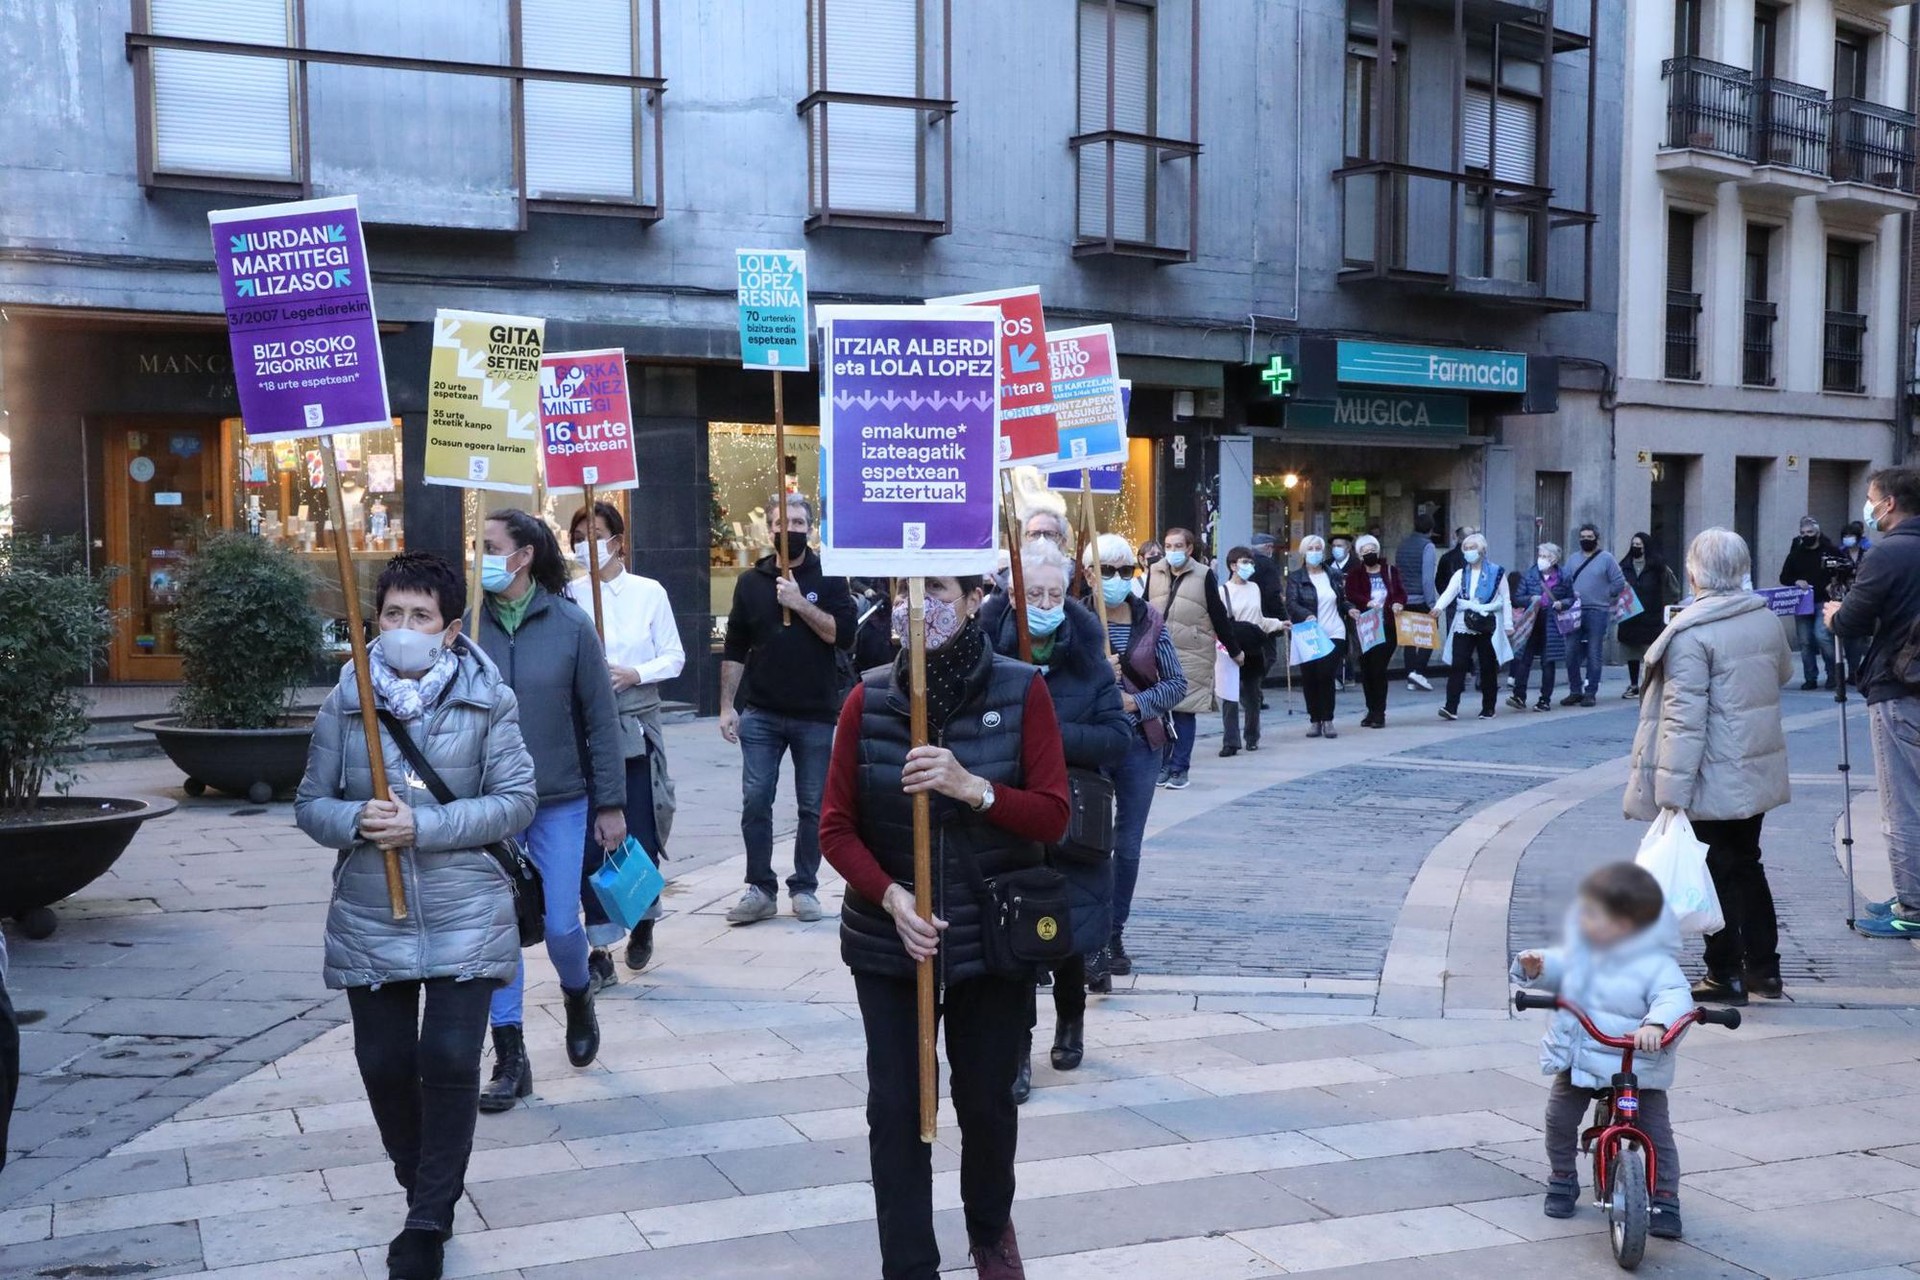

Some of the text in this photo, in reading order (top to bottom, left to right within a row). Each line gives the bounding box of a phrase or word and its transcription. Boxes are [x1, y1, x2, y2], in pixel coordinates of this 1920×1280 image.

[248, 226, 330, 252] IURDAN
[232, 247, 350, 277] MARTITEGI
[737, 256, 783, 273] LOLA
[255, 271, 334, 297] LIZASO
[738, 272, 795, 291] LOPEZ
[738, 290, 802, 307] RESINA
[230, 301, 370, 326] 3/2007 Legediarekin
[746, 311, 760, 322] 70
[489, 325, 541, 347] GITA
[747, 323, 796, 334] bizitza erdia
[253, 335, 356, 360] BIZI OSOKO
[748, 336, 797, 346] espetxean
[834, 338, 994, 357] ITZIAR ALBERDI
[488, 344, 541, 358] VICARIO
[1048, 351, 1090, 369] RINO
[254, 351, 360, 376] ZIGORRIK EZ!
[487, 356, 539, 372] SETIEN
[555, 362, 620, 381] GORKA
[834, 360, 865, 376] eta
[870, 359, 923, 377] LOLA
[928, 360, 993, 377] LOPEZ
[1428, 354, 1519, 386] Farmacia
[1050, 365, 1085, 382] BAO
[277, 379, 300, 390] urte
[433, 381, 467, 392] 20 urte
[433, 390, 479, 401] espetxean
[433, 410, 465, 420] 35 urte
[543, 399, 611, 416] MINTEGI
[1333, 397, 1431, 427] MUGICA
[433, 418, 493, 431] etxetik kanpo
[545, 420, 627, 442] 16 urte
[431, 438, 527, 454] Osasun egoera larrian
[547, 437, 628, 457] espetxean
[861, 443, 966, 463] izateagatik
[861, 465, 960, 482] espetxean
[863, 482, 965, 500] baztertuak
